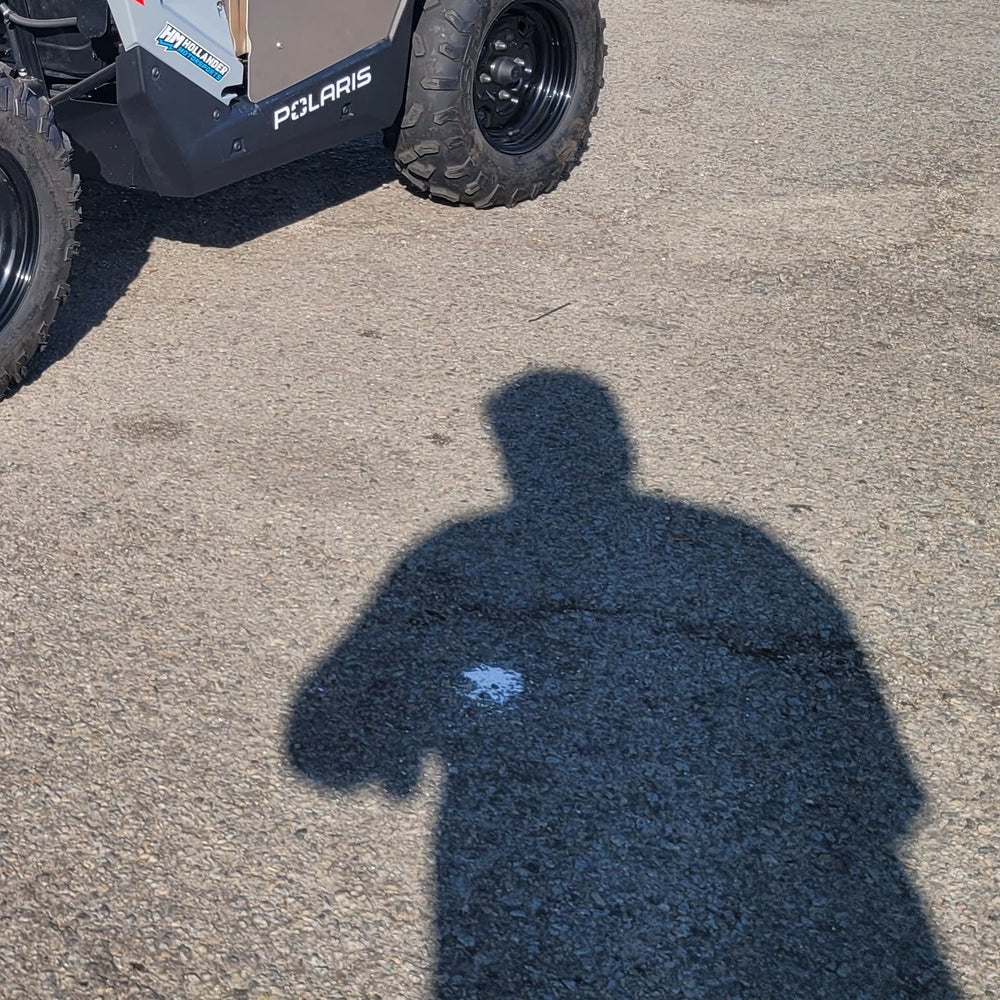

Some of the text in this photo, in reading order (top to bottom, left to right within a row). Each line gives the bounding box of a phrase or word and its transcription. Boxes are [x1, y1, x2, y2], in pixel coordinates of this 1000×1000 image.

[159, 24, 185, 49] HM
[177, 46, 223, 80] MOTORSPORTS
[181, 38, 228, 76] HOLLANDER
[274, 65, 372, 130] POLARIS
